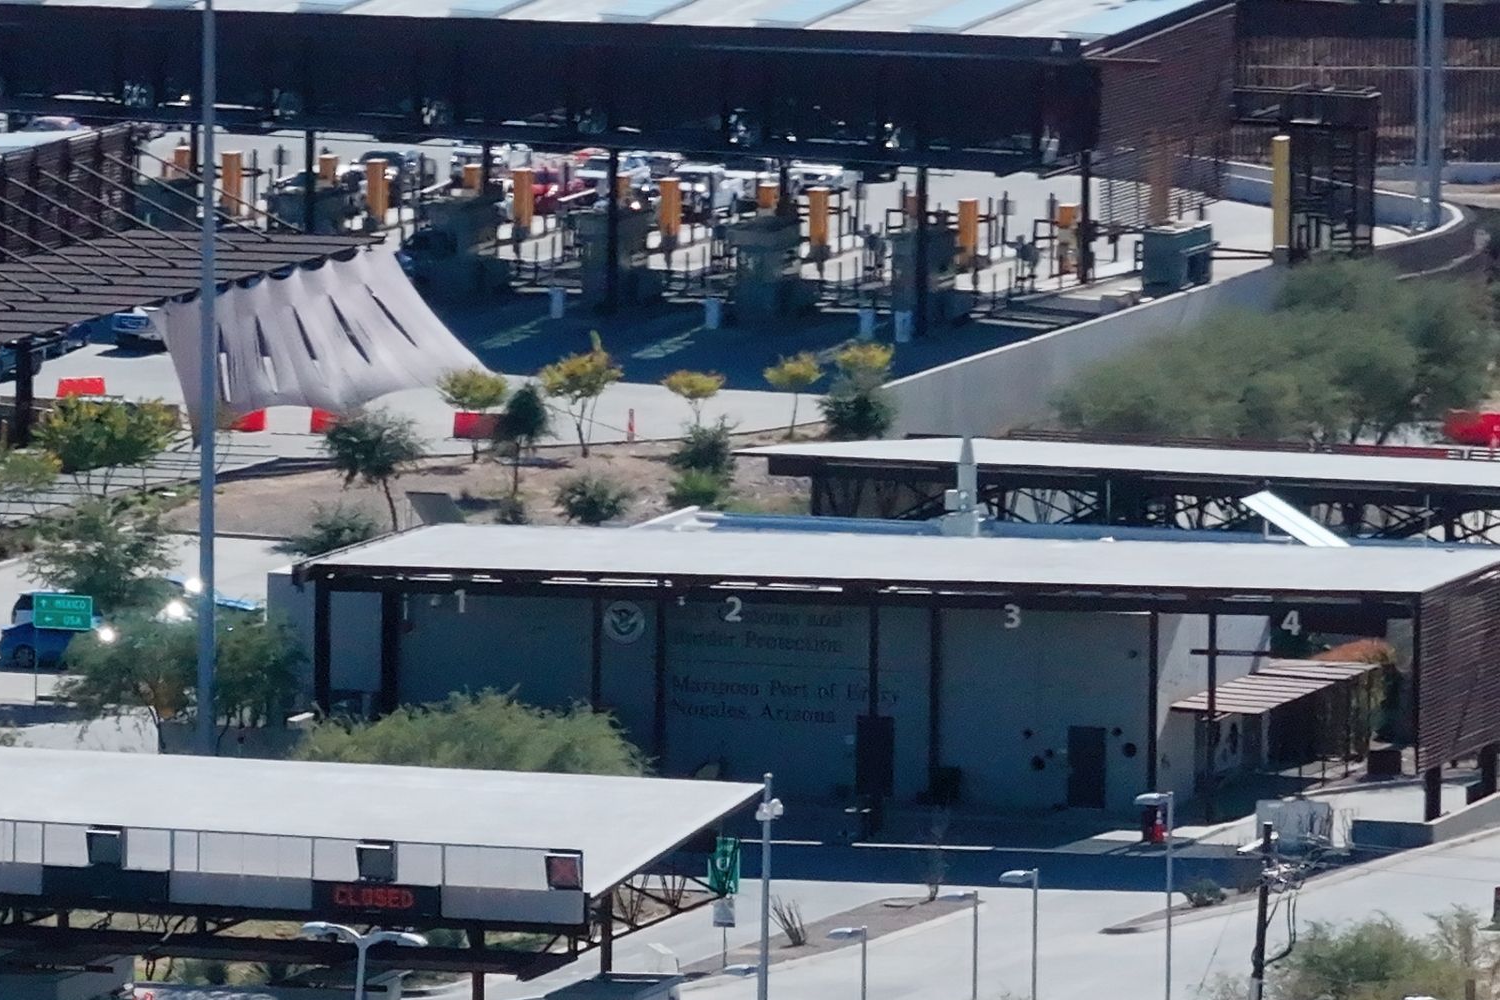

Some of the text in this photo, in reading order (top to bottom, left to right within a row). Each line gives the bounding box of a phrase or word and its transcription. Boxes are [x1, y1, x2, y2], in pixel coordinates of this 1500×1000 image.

[454, 589, 466, 613] 1
[725, 596, 743, 622] 2
[1004, 603, 1021, 629] 3
[1281, 609, 1301, 636] 4
[745, 631, 843, 653] Protection
[671, 675, 760, 697] Mariposa
[769, 679, 808, 698] Port
[818, 683, 837, 699] of
[761, 703, 837, 724] Arizona
[334, 885, 414, 909] CLOSED
